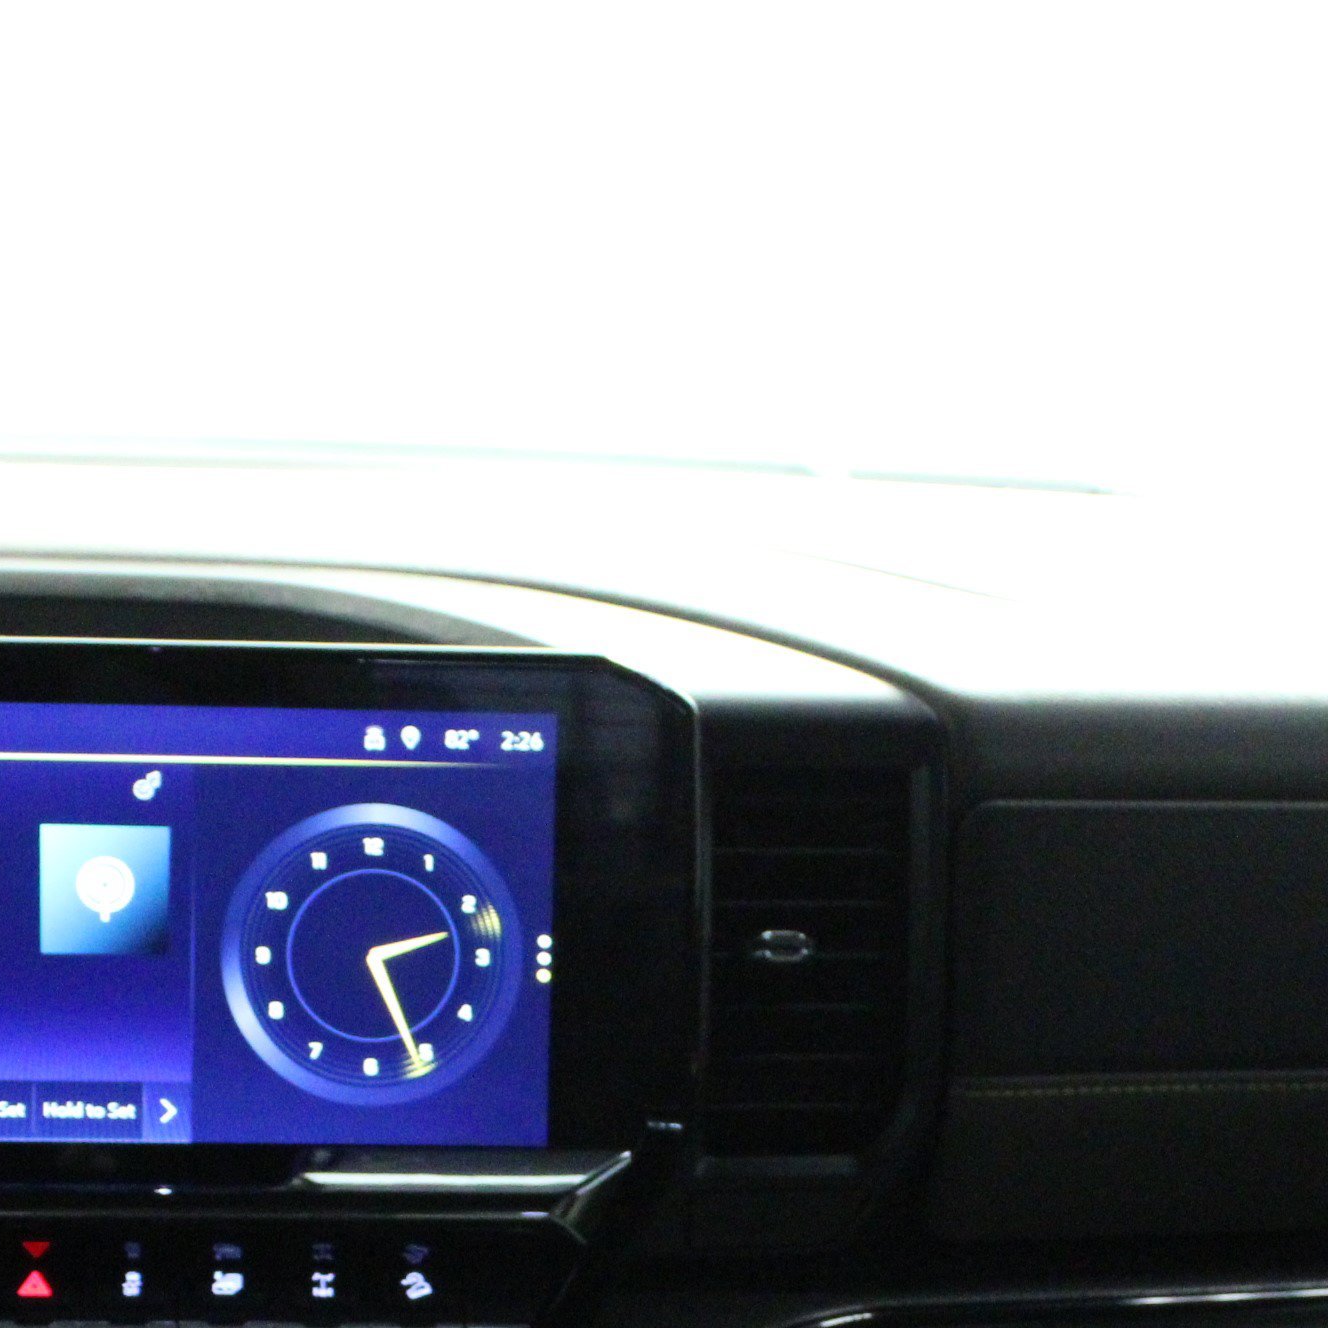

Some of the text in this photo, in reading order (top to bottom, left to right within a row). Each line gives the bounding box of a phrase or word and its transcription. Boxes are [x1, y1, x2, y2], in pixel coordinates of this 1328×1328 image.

[501, 731, 544, 751] 2:26
[363, 837, 384, 856] 12
[423, 854, 434, 872] 1
[265, 891, 288, 910] 10
[461, 895, 477, 914] 2
[255, 946, 271, 965] 9
[475, 948, 491, 967] 3
[457, 1004, 473, 1022] 4
[308, 1042, 323, 1060] 7
[43, 1101, 137, 1119] Hold to Set
